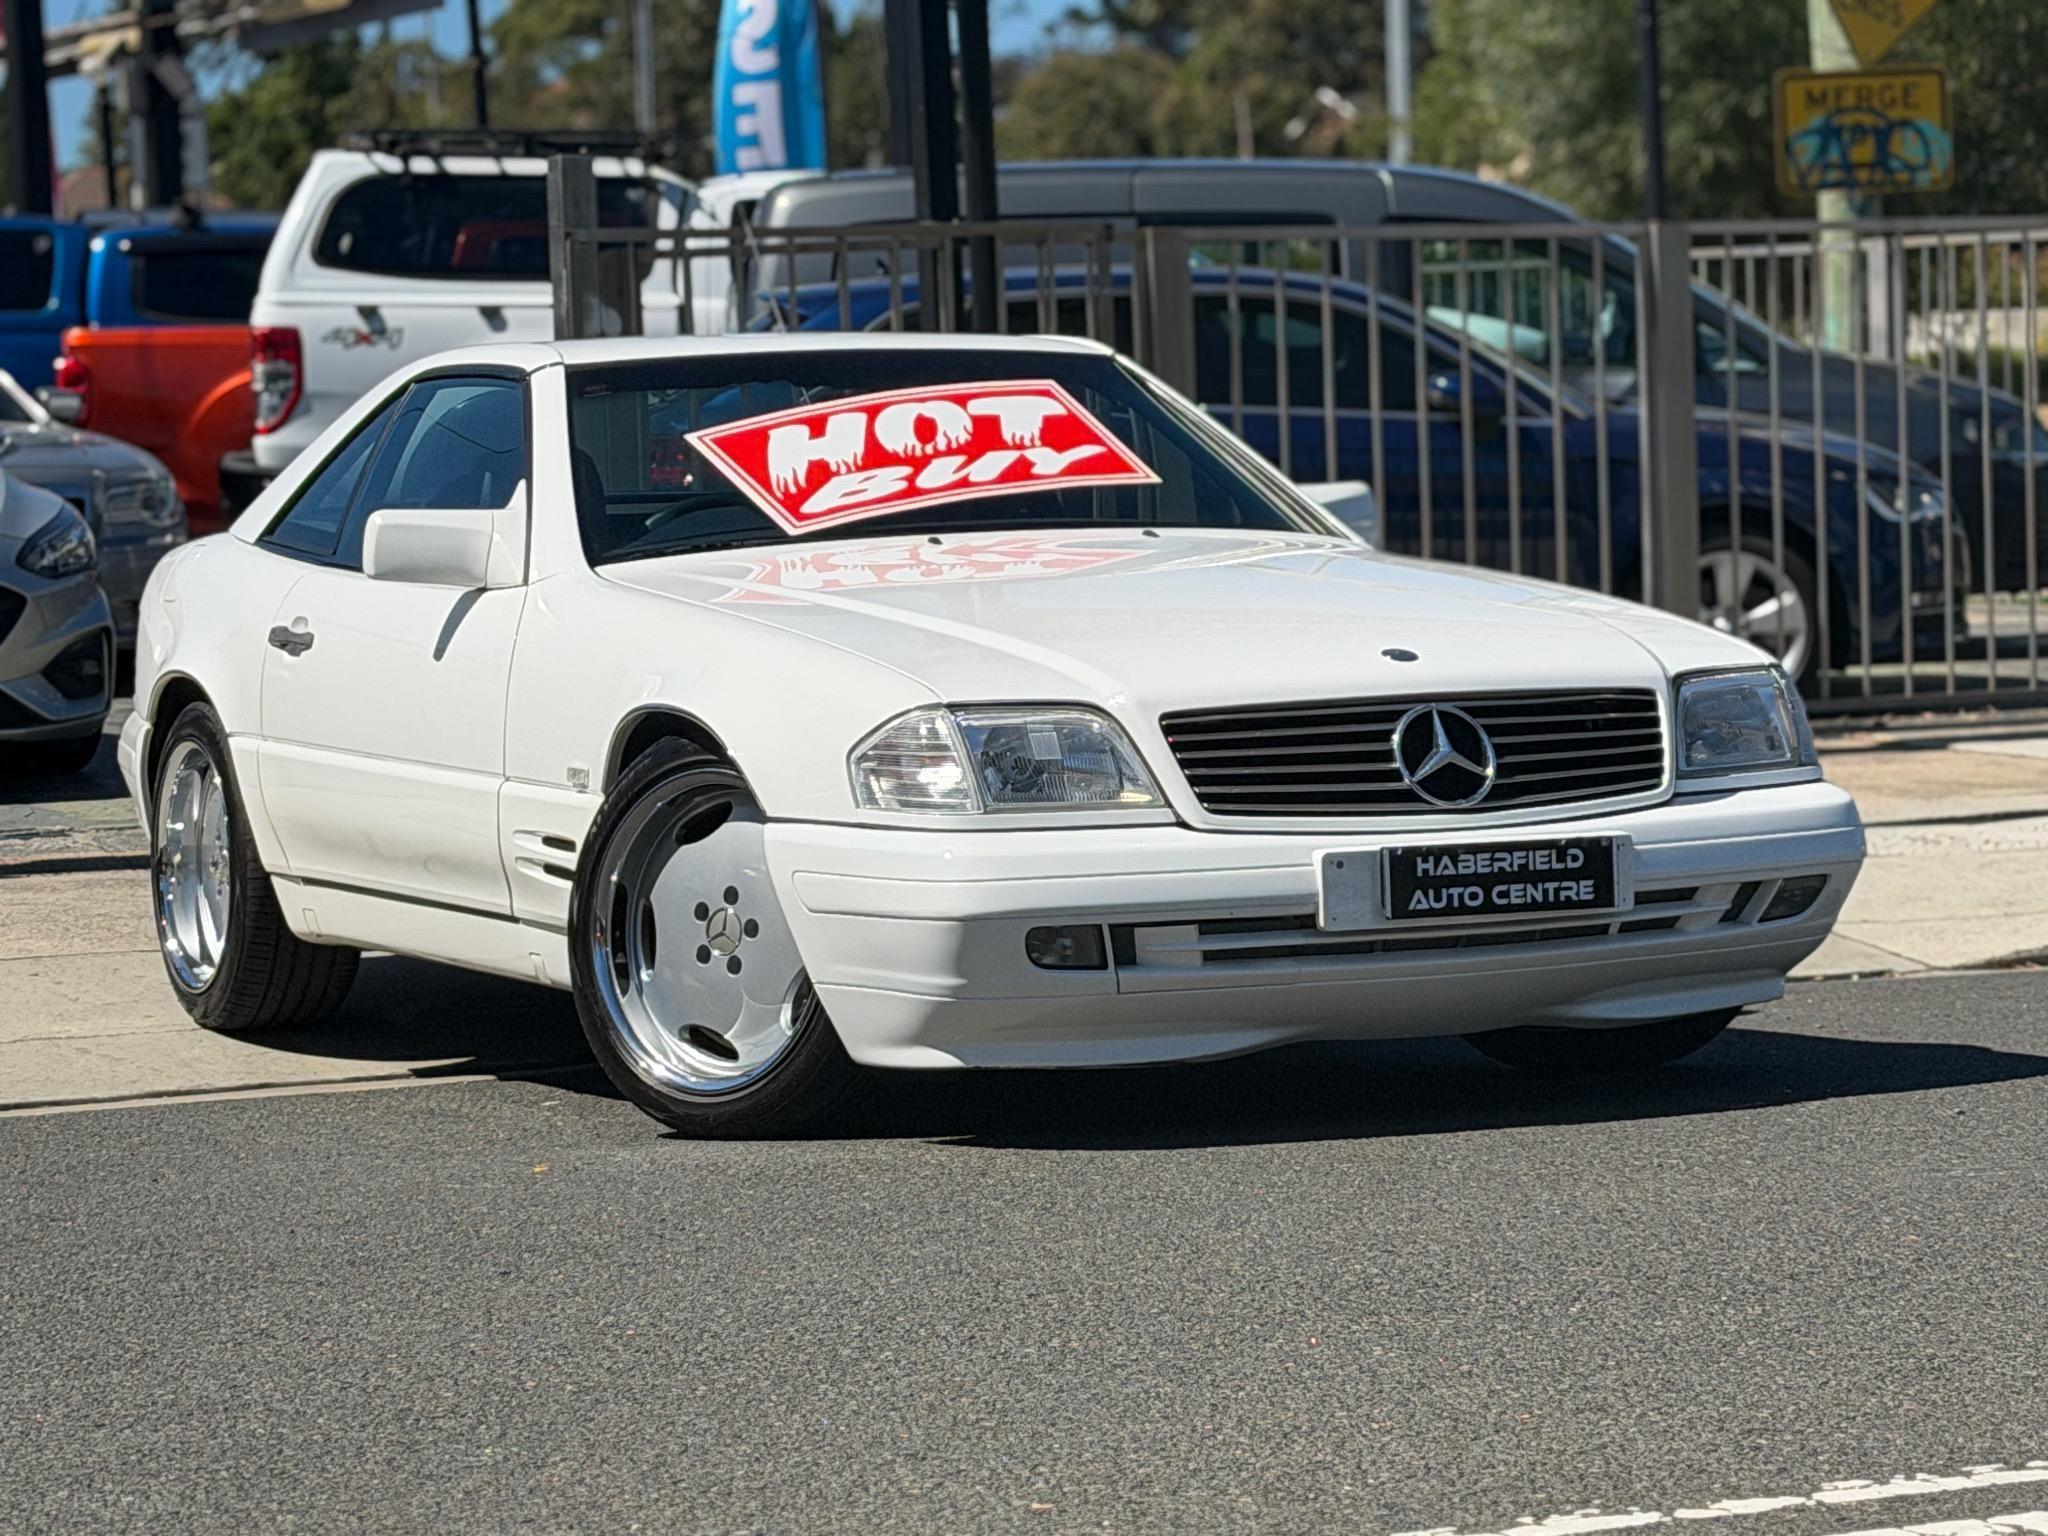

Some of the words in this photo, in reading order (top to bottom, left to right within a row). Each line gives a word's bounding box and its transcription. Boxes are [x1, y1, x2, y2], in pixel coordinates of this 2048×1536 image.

[1805, 82, 1921, 111] MERGE
[767, 396, 1069, 499] HOT
[800, 444, 1108, 513] BUY
[1416, 848, 1585, 877] HABERFIELD
[1408, 886, 1485, 911] AUTO
[1491, 880, 1596, 905] CENTRE
